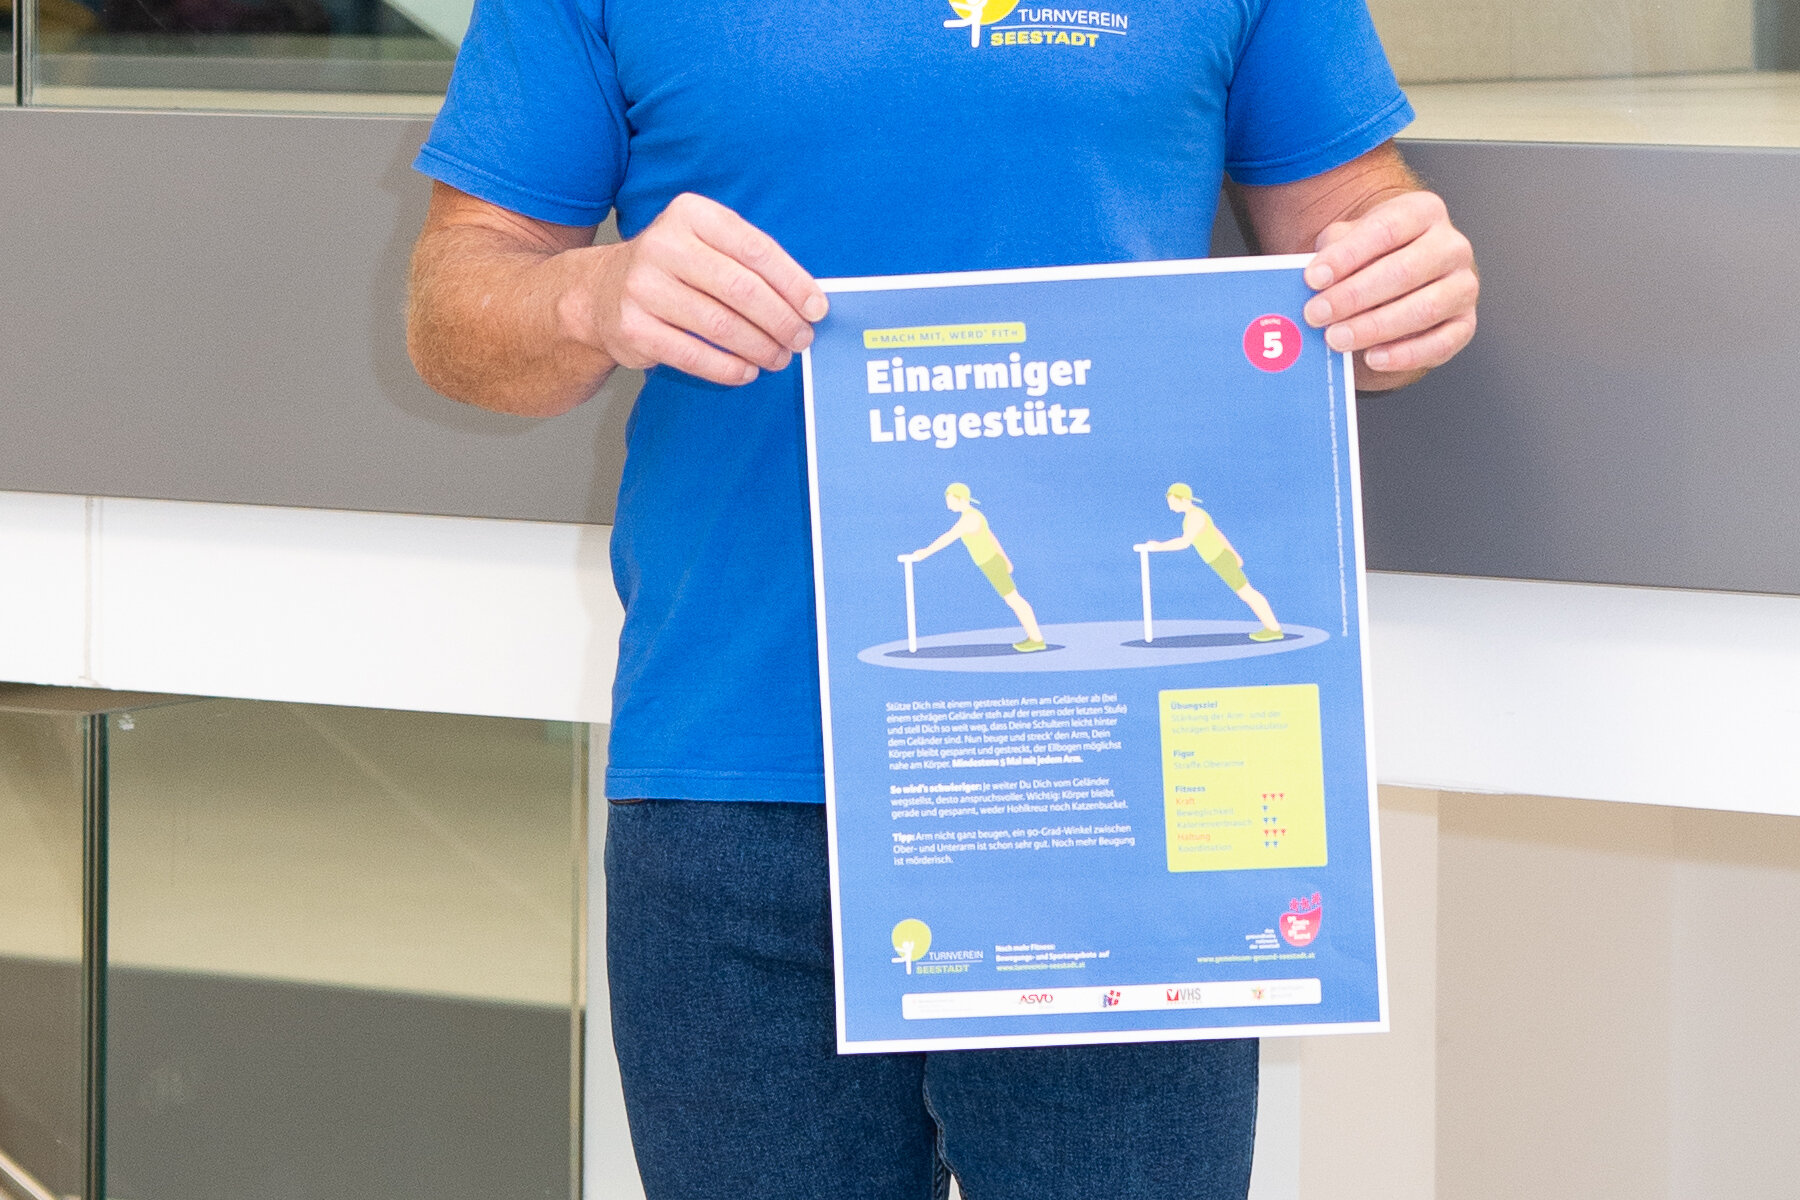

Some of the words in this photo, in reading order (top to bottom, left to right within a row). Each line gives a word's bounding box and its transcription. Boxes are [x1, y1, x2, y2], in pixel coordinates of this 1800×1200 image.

[1017, 8, 1129, 29] TURNVEREIN
[990, 30, 1100, 48] SEESTADT
[919, 331, 944, 342] MIT,
[1262, 331, 1284, 359] 5
[866, 351, 1091, 396] Einarmiger
[868, 399, 1091, 449] Liegestütz
[911, 700, 931, 710] Dich
[931, 700, 946, 709] mit
[946, 699, 972, 709] einem
[972, 697, 1019, 710] gestreckten
[1020, 696, 1038, 705] Arm
[1038, 697, 1052, 705] am
[1052, 694, 1089, 705] Geländer
[1089, 693, 1101, 703] ab
[1170, 700, 1218, 711] Übungsziel
[885, 713, 911, 723] einem
[911, 712, 947, 723] schrägen
[947, 710, 984, 721] Geländer
[1002, 708, 1016, 718] auf
[1016, 708, 1030, 718] der
[1030, 708, 1056, 717] ersten
[1055, 706, 1075, 716] oder
[886, 725, 903, 735] und
[920, 723, 940, 734] Dich
[940, 725, 951, 733] so
[950, 723, 969, 732] weit
[989, 721, 1008, 731] dass
[1007, 720, 1032, 730] Deine
[1031, 719, 1070, 729] Schultern
[1070, 717, 1093, 727] leicht
[1093, 716, 1117, 726] hinter
[887, 737, 906, 747] dem
[906, 735, 943, 746] Geländer
[963, 734, 982, 743] Nun
[982, 733, 1008, 744] beuge
[1009, 732, 1026, 742] und
[1053, 730, 1070, 740] den
[1091, 728, 1110, 738] Dein
[888, 749, 915, 760] Körper
[915, 747, 939, 758] bleibt
[939, 746, 976, 759] gespannt
[976, 745, 993, 755] und
[1032, 743, 1047, 753] der
[1082, 740, 1122, 752] möglichst
[1172, 749, 1195, 760] Figur
[889, 760, 909, 770] nahe
[909, 761, 922, 770] am
[1022, 755, 1036, 765] mit
[889, 784, 902, 795] So
[991, 780, 1017, 790] weiter
[1018, 779, 1031, 789] Du
[1032, 778, 1052, 789] Dich
[1052, 779, 1071, 787] vom
[1072, 776, 1109, 787] Geländer
[1174, 784, 1206, 793] Fitness
[935, 794, 959, 804] desto
[1061, 789, 1089, 800] Körper
[1090, 788, 1114, 798] bleibt
[1175, 796, 1195, 806] Kraft
[890, 807, 920, 820] gerade
[920, 806, 937, 817] und
[979, 804, 1005, 814] weder
[1006, 803, 1048, 813] Hohlkreuz
[1049, 801, 1071, 811] noch
[915, 832, 933, 842] Arm
[933, 830, 955, 840] nicht
[956, 831, 976, 841] ganz
[1011, 828, 1025, 837] ein
[1093, 823, 1131, 834] zwischen
[1176, 832, 1211, 843] Haltung
[918, 843, 935, 853] und
[936, 843, 975, 852] Unterarm
[976, 841, 987, 850] ist
[987, 840, 1013, 850] schon
[1014, 839, 1032, 849] sehr
[1051, 837, 1074, 847] Noch
[1074, 836, 1097, 846] mehr
[1098, 836, 1135, 847] Beugung
[893, 856, 904, 865] ist
[929, 950, 984, 960] TURNVEREIN
[916, 963, 969, 974] SEESTADT
[1178, 987, 1202, 1001] VHS
